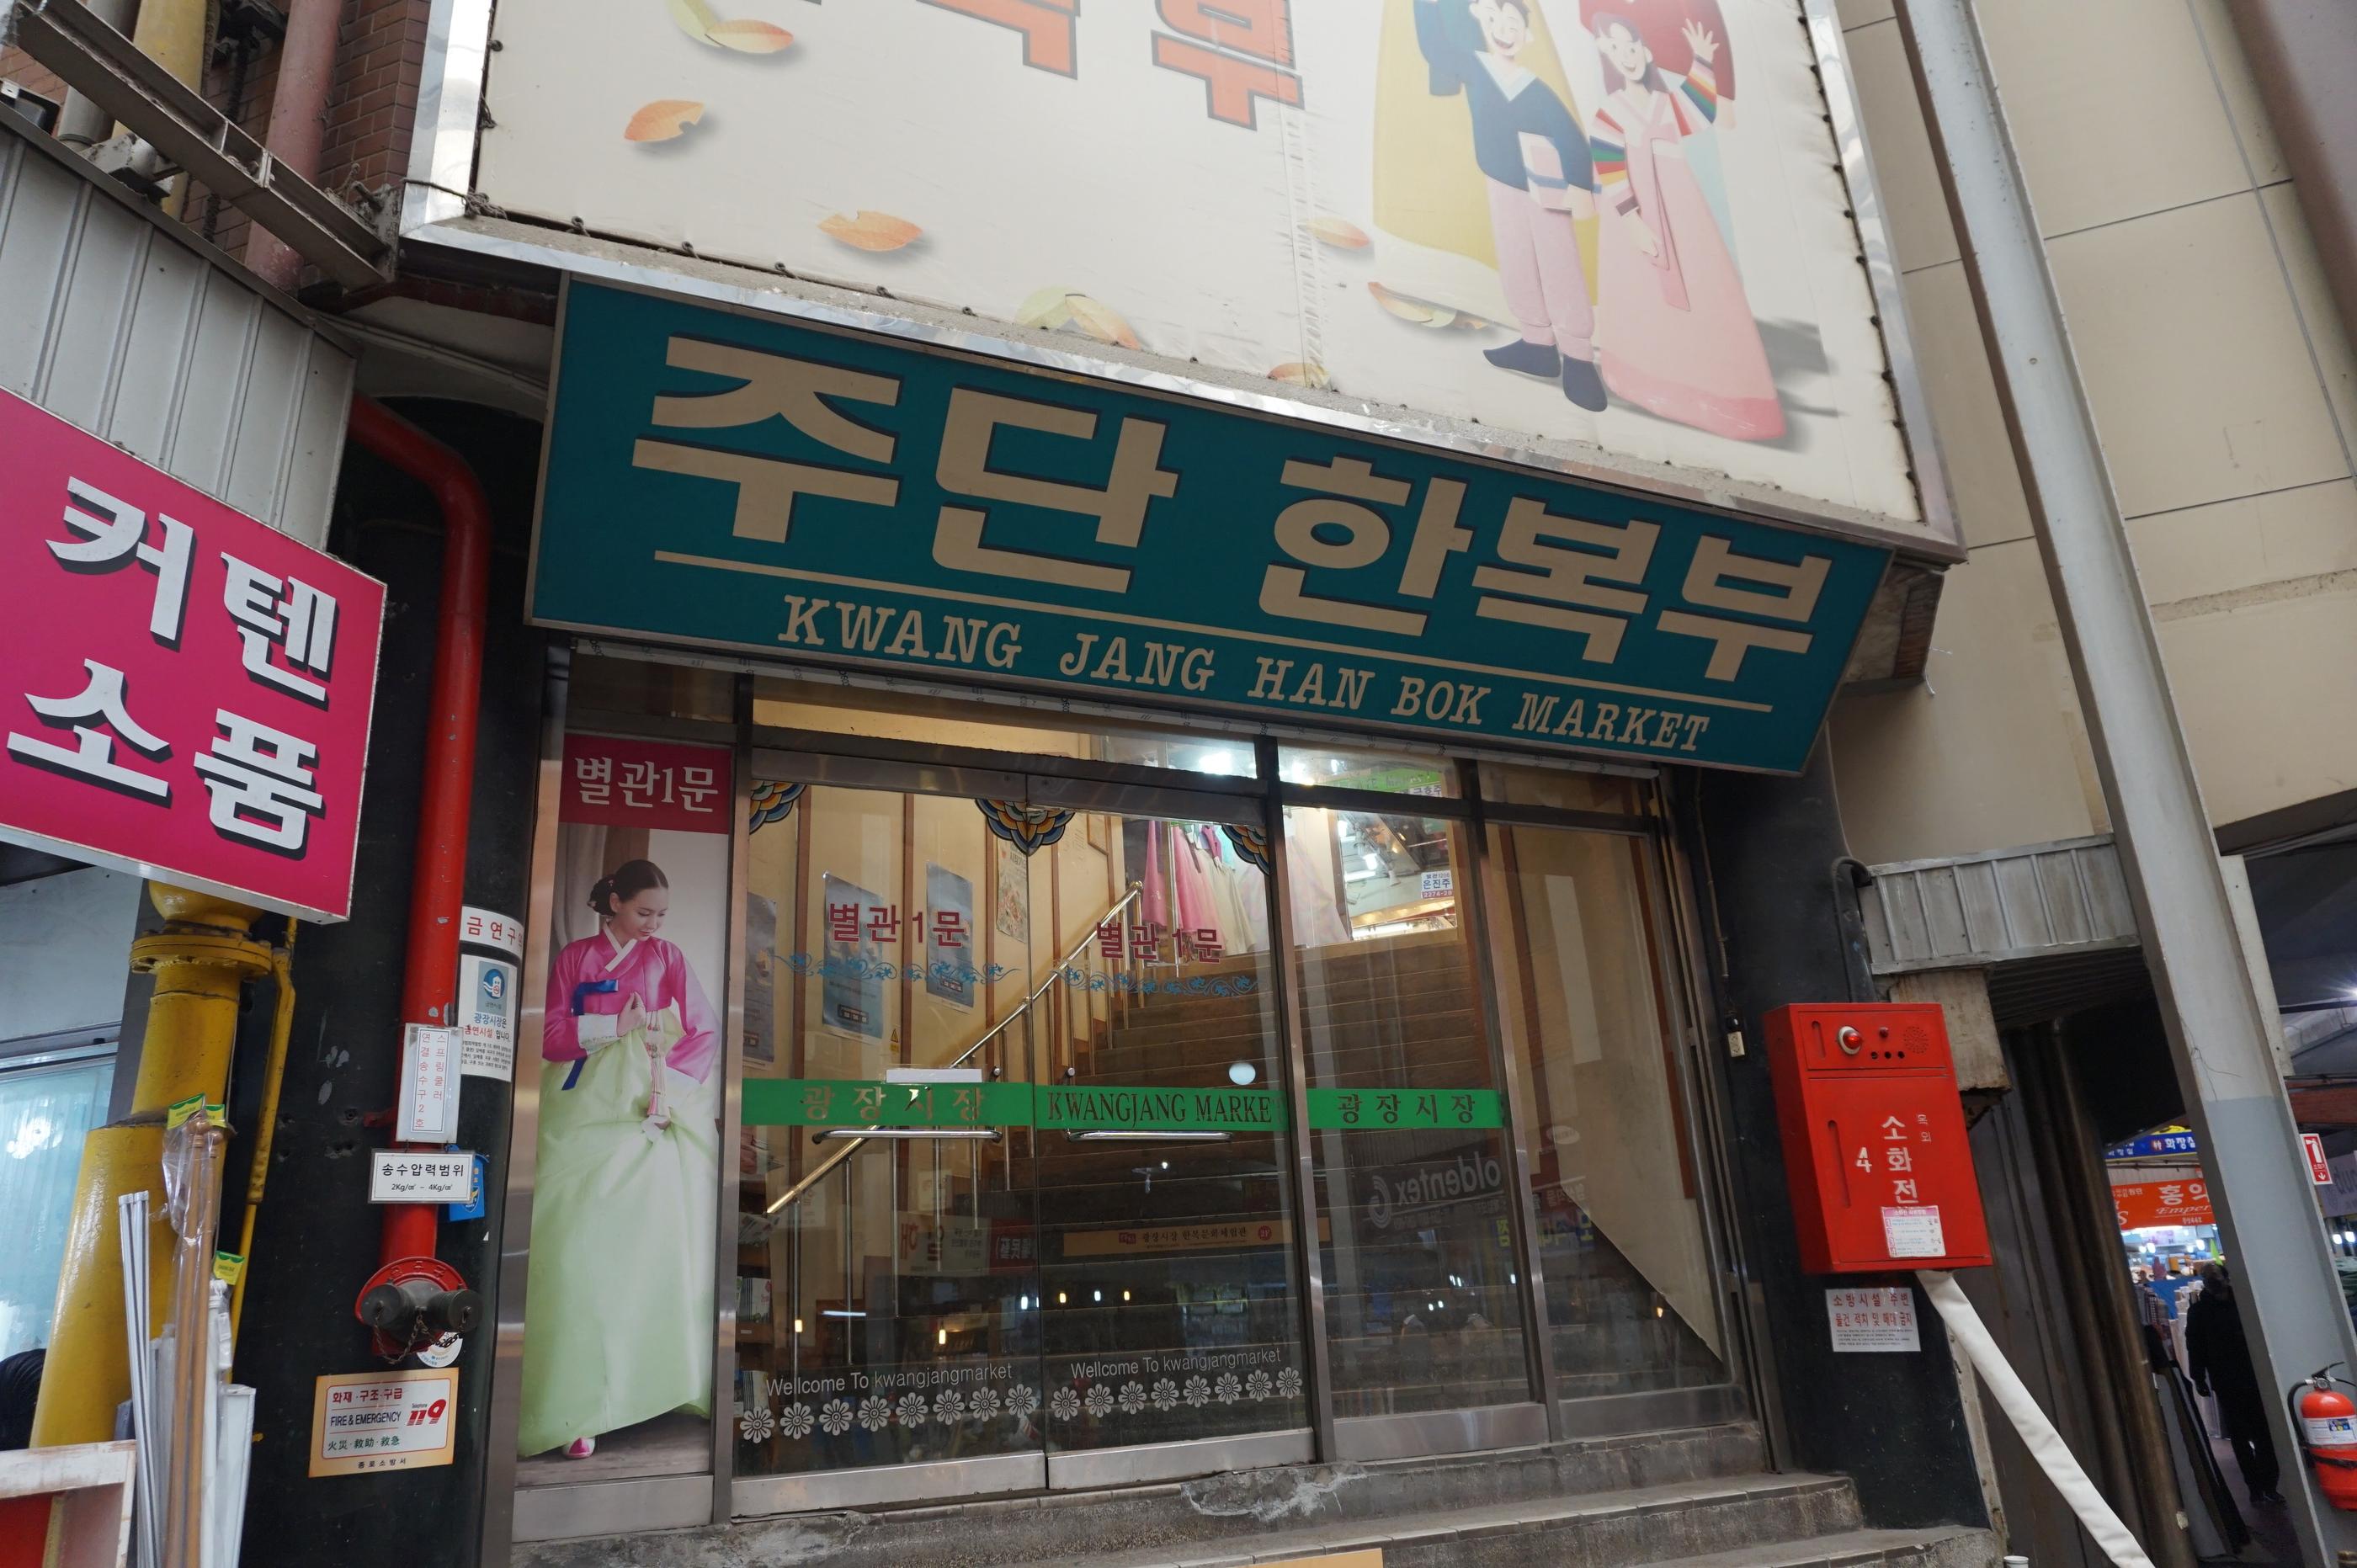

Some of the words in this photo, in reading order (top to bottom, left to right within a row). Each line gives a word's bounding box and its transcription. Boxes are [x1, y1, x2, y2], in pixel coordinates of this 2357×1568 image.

[631, 335, 1179, 593] 주단
[1258, 455, 1833, 683] 한복부
[45, 476, 338, 703] 커텐
[778, 594, 1022, 668] KWANG
[1060, 633, 1215, 691] JANG
[1247, 656, 1375, 710] HAN
[1391, 676, 1491, 726] BOK
[1512, 692, 1711, 752] MARKET
[7, 658, 323, 850] 소품
[574, 757, 719, 813] 별관1문
[828, 903, 967, 948] 별관1문
[1097, 922, 1222, 963] 별관1문
[802, 1086, 987, 1121] 광장시장
[1046, 1091, 1186, 1126] KWANGJANG
[1336, 1093, 1476, 1125] 광장시장
[381, 1162, 464, 1177] 송수압력범위
[1855, 1146, 1873, 1173] 4
[1881, 1115, 1919, 1204] 소화전
[766, 1375, 846, 1397] Wellcome
[850, 1371, 870, 1390] To
[874, 1363, 1014, 1390] kwangjangmarket
[1070, 1360, 1139, 1379] Wellcome
[1142, 1356, 1159, 1374] To
[1163, 1347, 1282, 1372] kwangjangmarket
[331, 1415, 348, 1427] FIRE
[348, 1415, 354, 1425] &
[355, 1411, 402, 1425] EMERGENCY
[406, 1398, 447, 1427] 119
